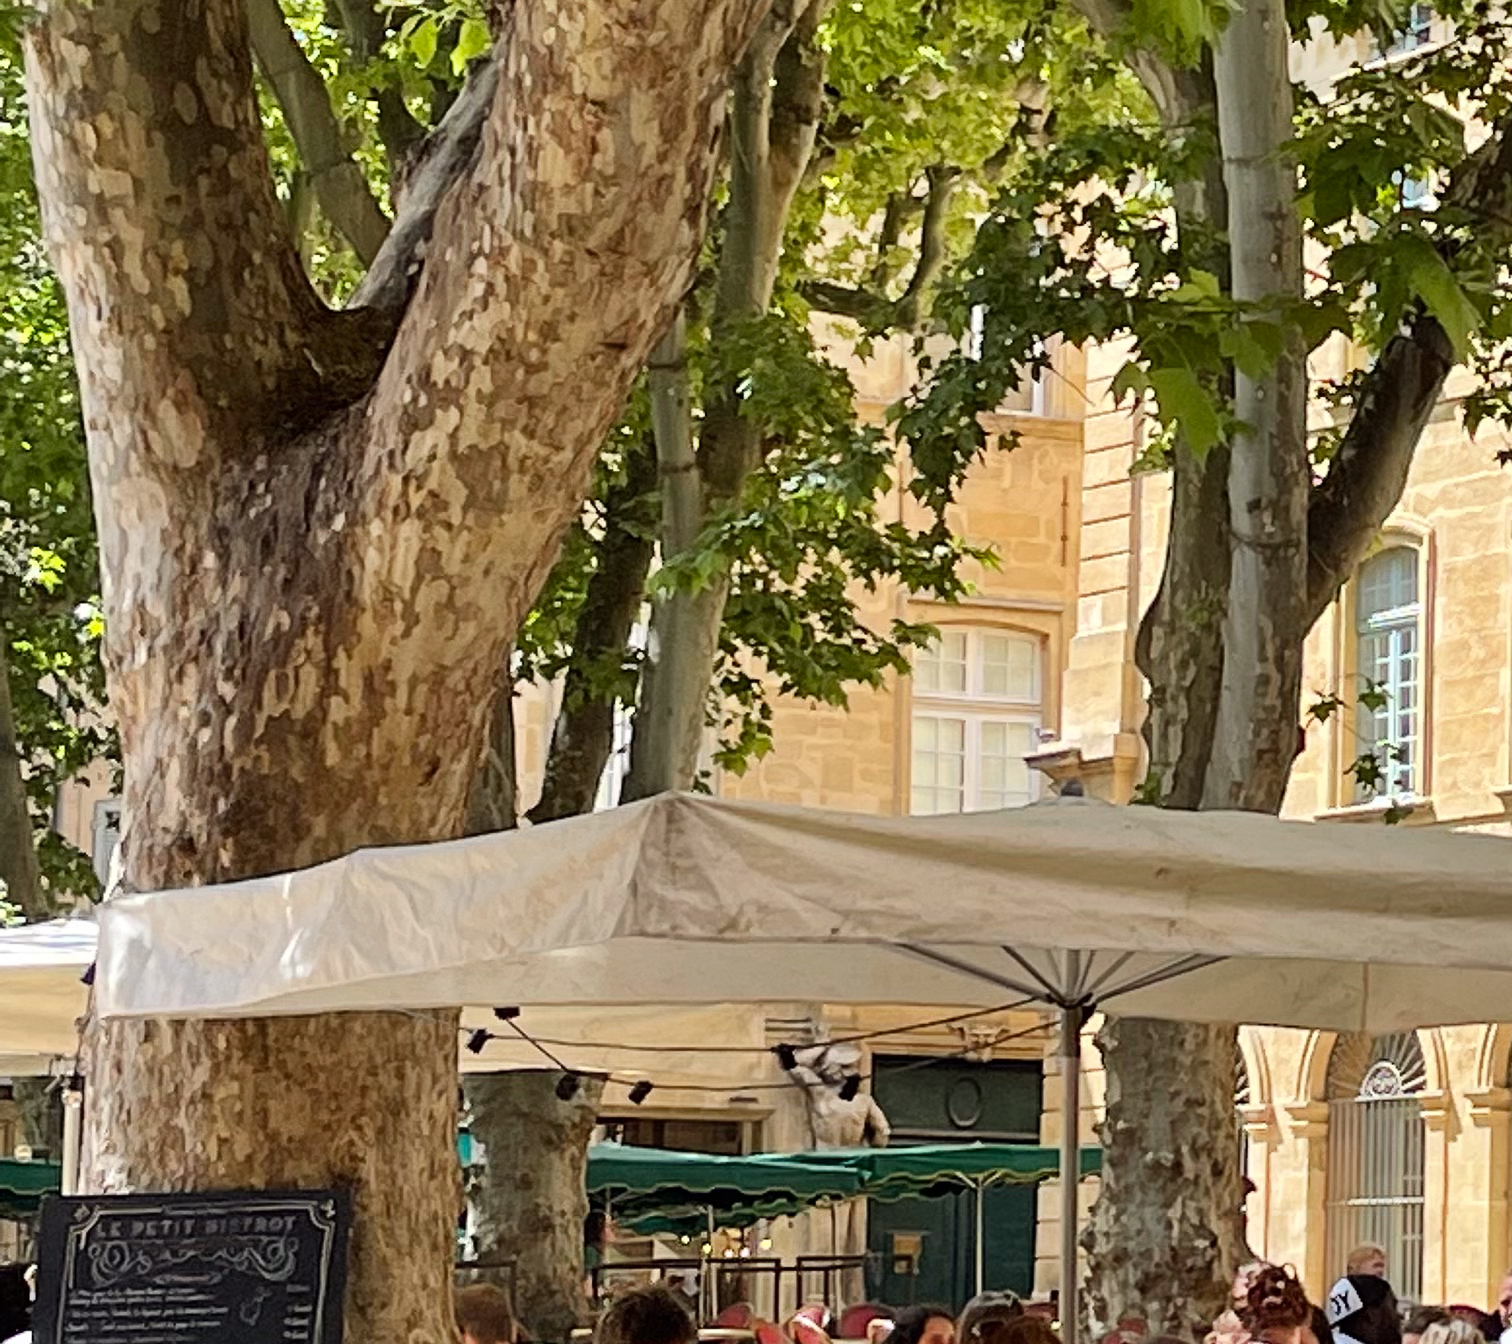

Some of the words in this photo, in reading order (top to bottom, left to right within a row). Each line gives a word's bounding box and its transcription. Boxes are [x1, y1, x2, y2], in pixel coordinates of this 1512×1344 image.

[96, 1219, 122, 1238] LE
[132, 1218, 196, 1237] PETIT
[205, 1216, 297, 1234] BISTROT
